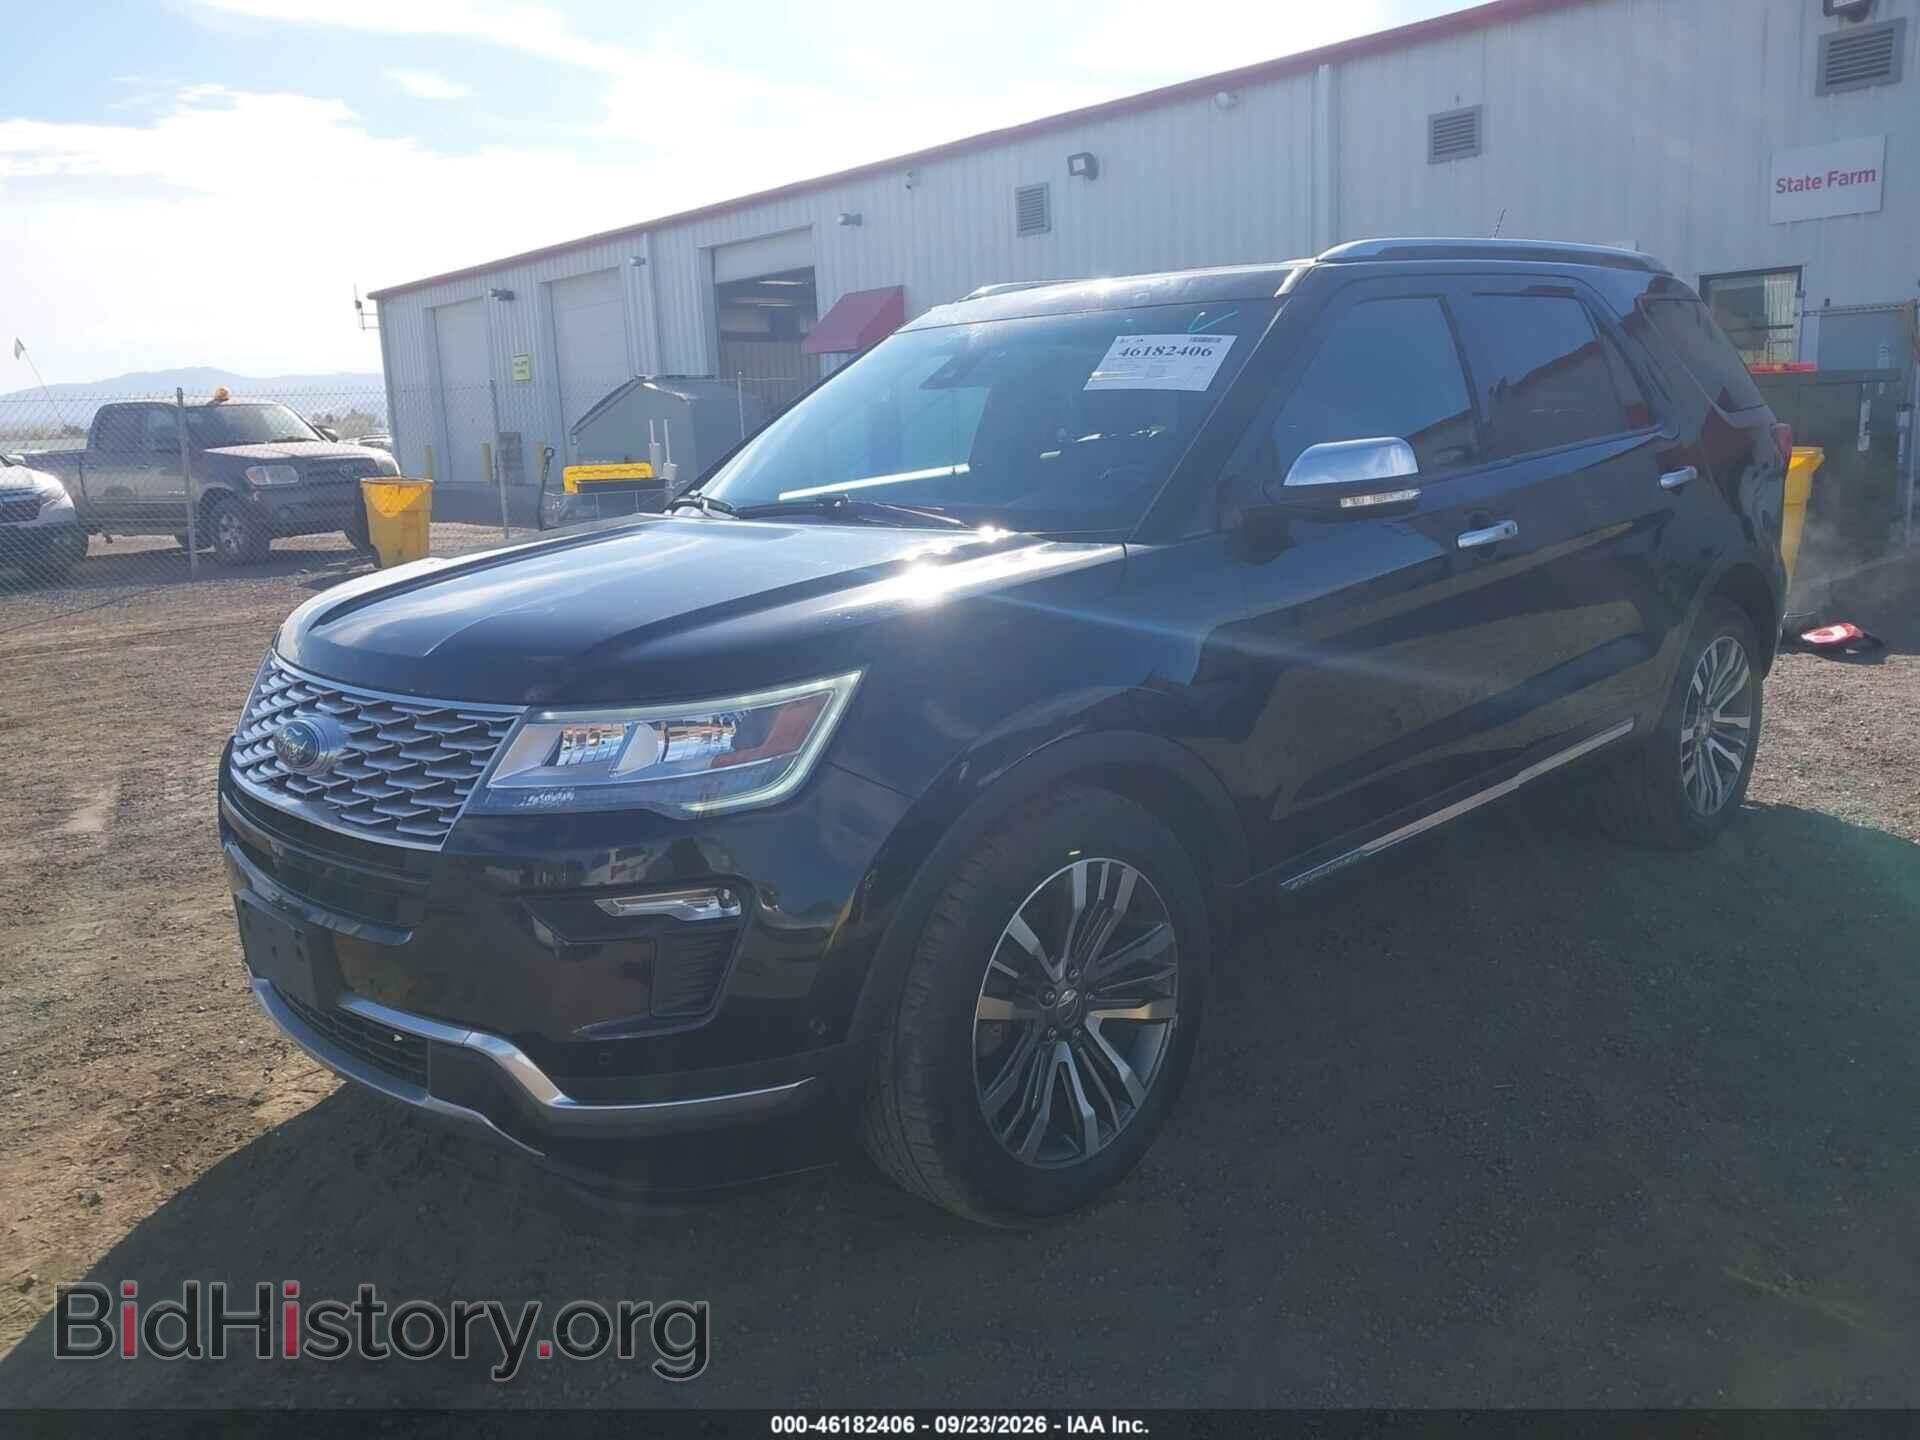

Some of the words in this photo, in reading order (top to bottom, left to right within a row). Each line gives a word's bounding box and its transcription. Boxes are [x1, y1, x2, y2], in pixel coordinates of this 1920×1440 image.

[1775, 172, 1823, 194] State
[1827, 168, 1876, 188] Farm
[1118, 345, 1213, 357] 46182406
